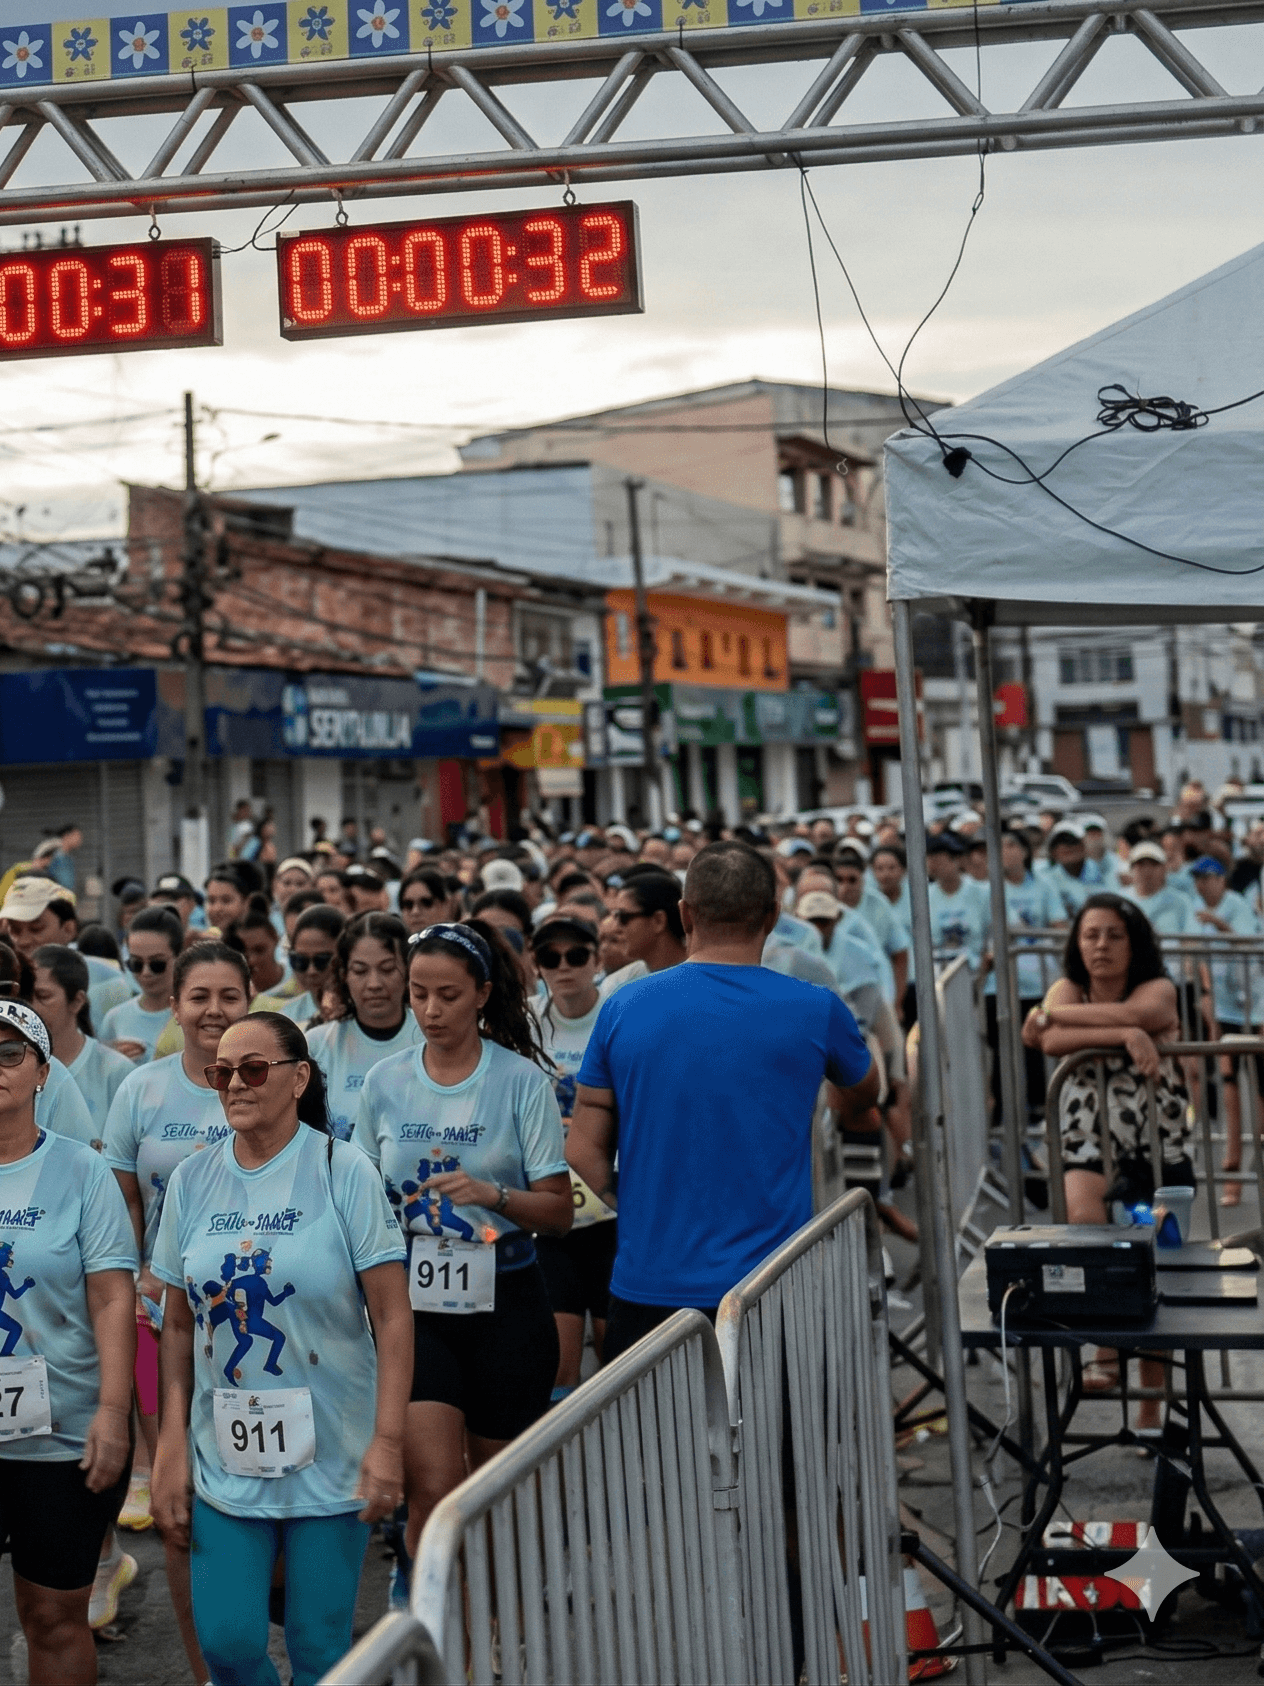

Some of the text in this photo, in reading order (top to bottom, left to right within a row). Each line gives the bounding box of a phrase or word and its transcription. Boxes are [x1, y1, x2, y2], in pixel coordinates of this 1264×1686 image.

[288, 213, 623, 321] 00:00:32
[417, 1259, 469, 1291] 911
[230, 1419, 286, 1453] 911
